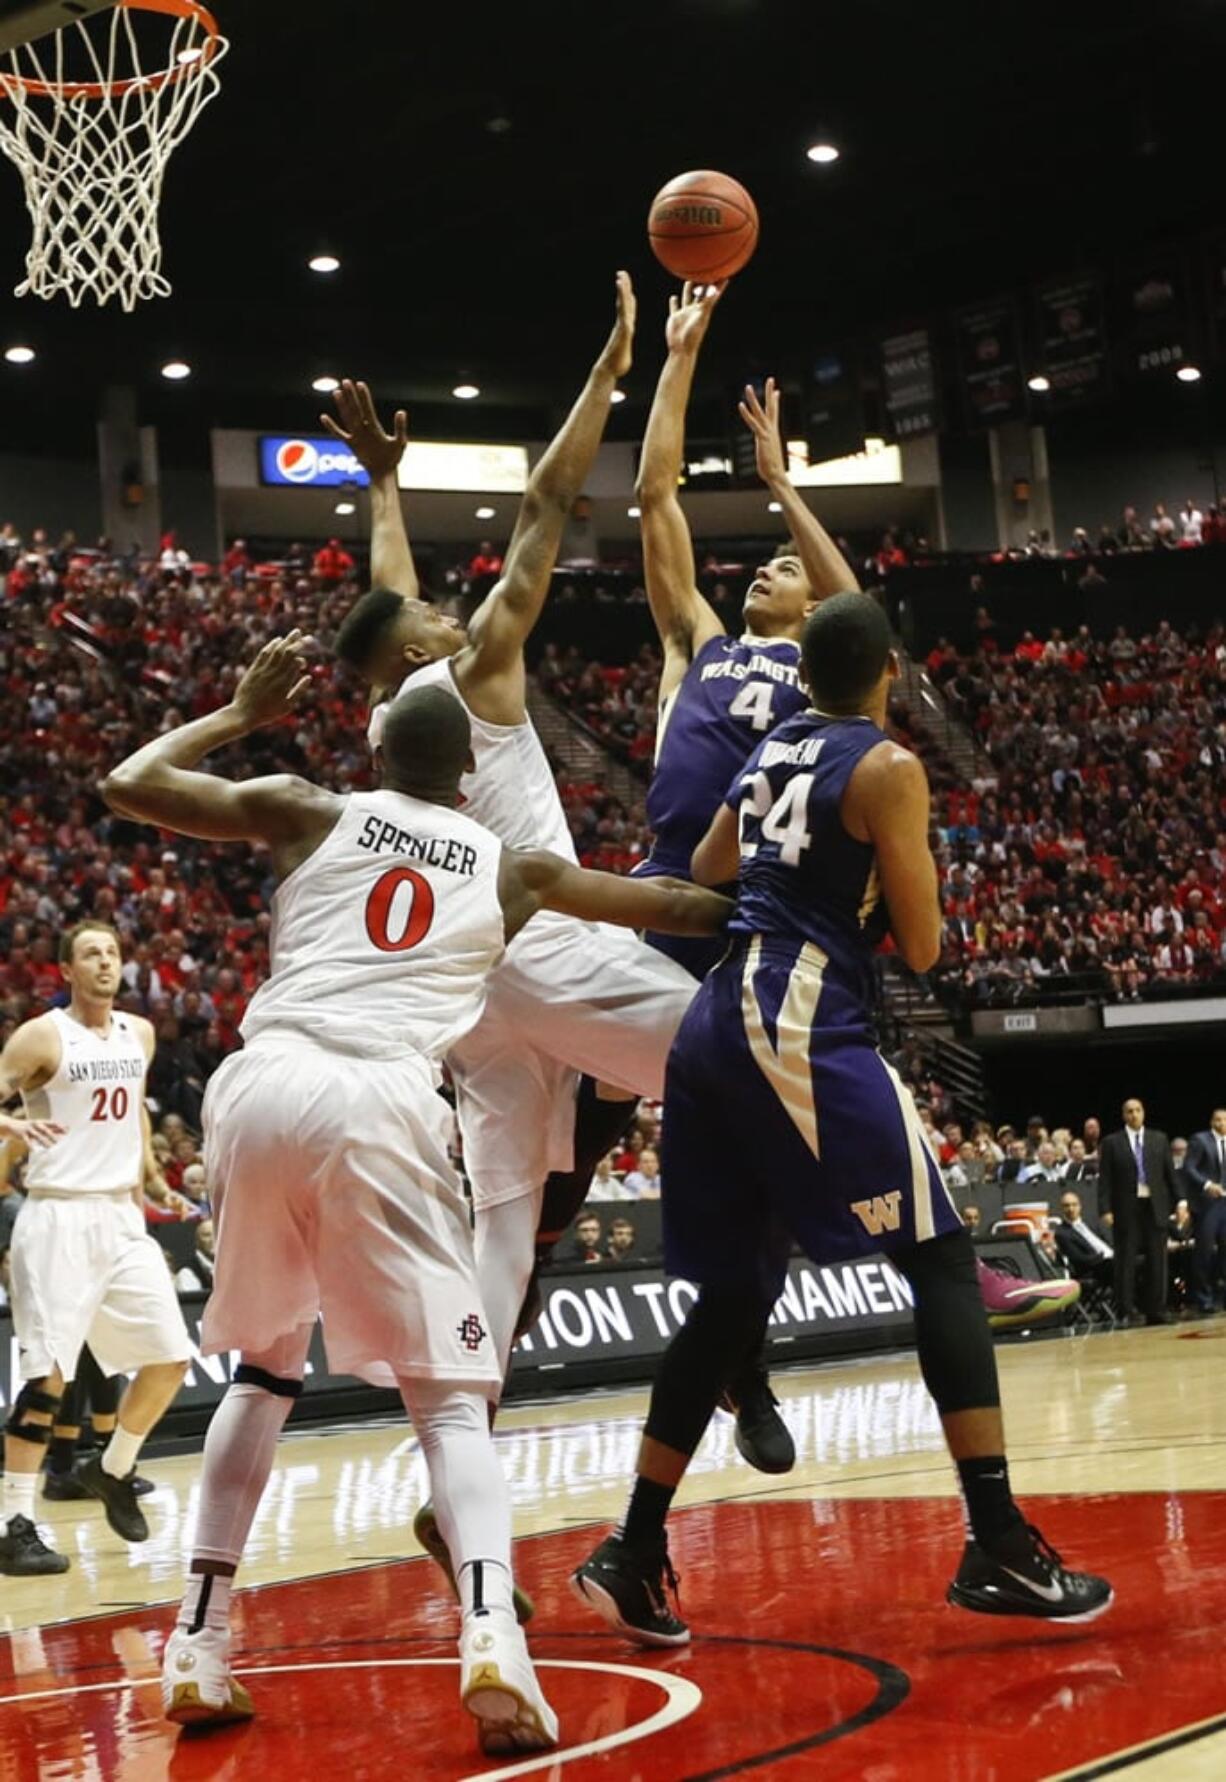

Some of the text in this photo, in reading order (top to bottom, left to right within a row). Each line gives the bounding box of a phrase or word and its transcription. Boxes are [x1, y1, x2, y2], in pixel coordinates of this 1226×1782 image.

[729, 681, 774, 731] 4
[739, 770, 815, 867] 24
[357, 815, 478, 876] SPENCER
[365, 866, 435, 953] 0
[69, 1062, 89, 1082] SAN
[91, 1087, 128, 1121] 20
[850, 1190, 902, 1236] W
